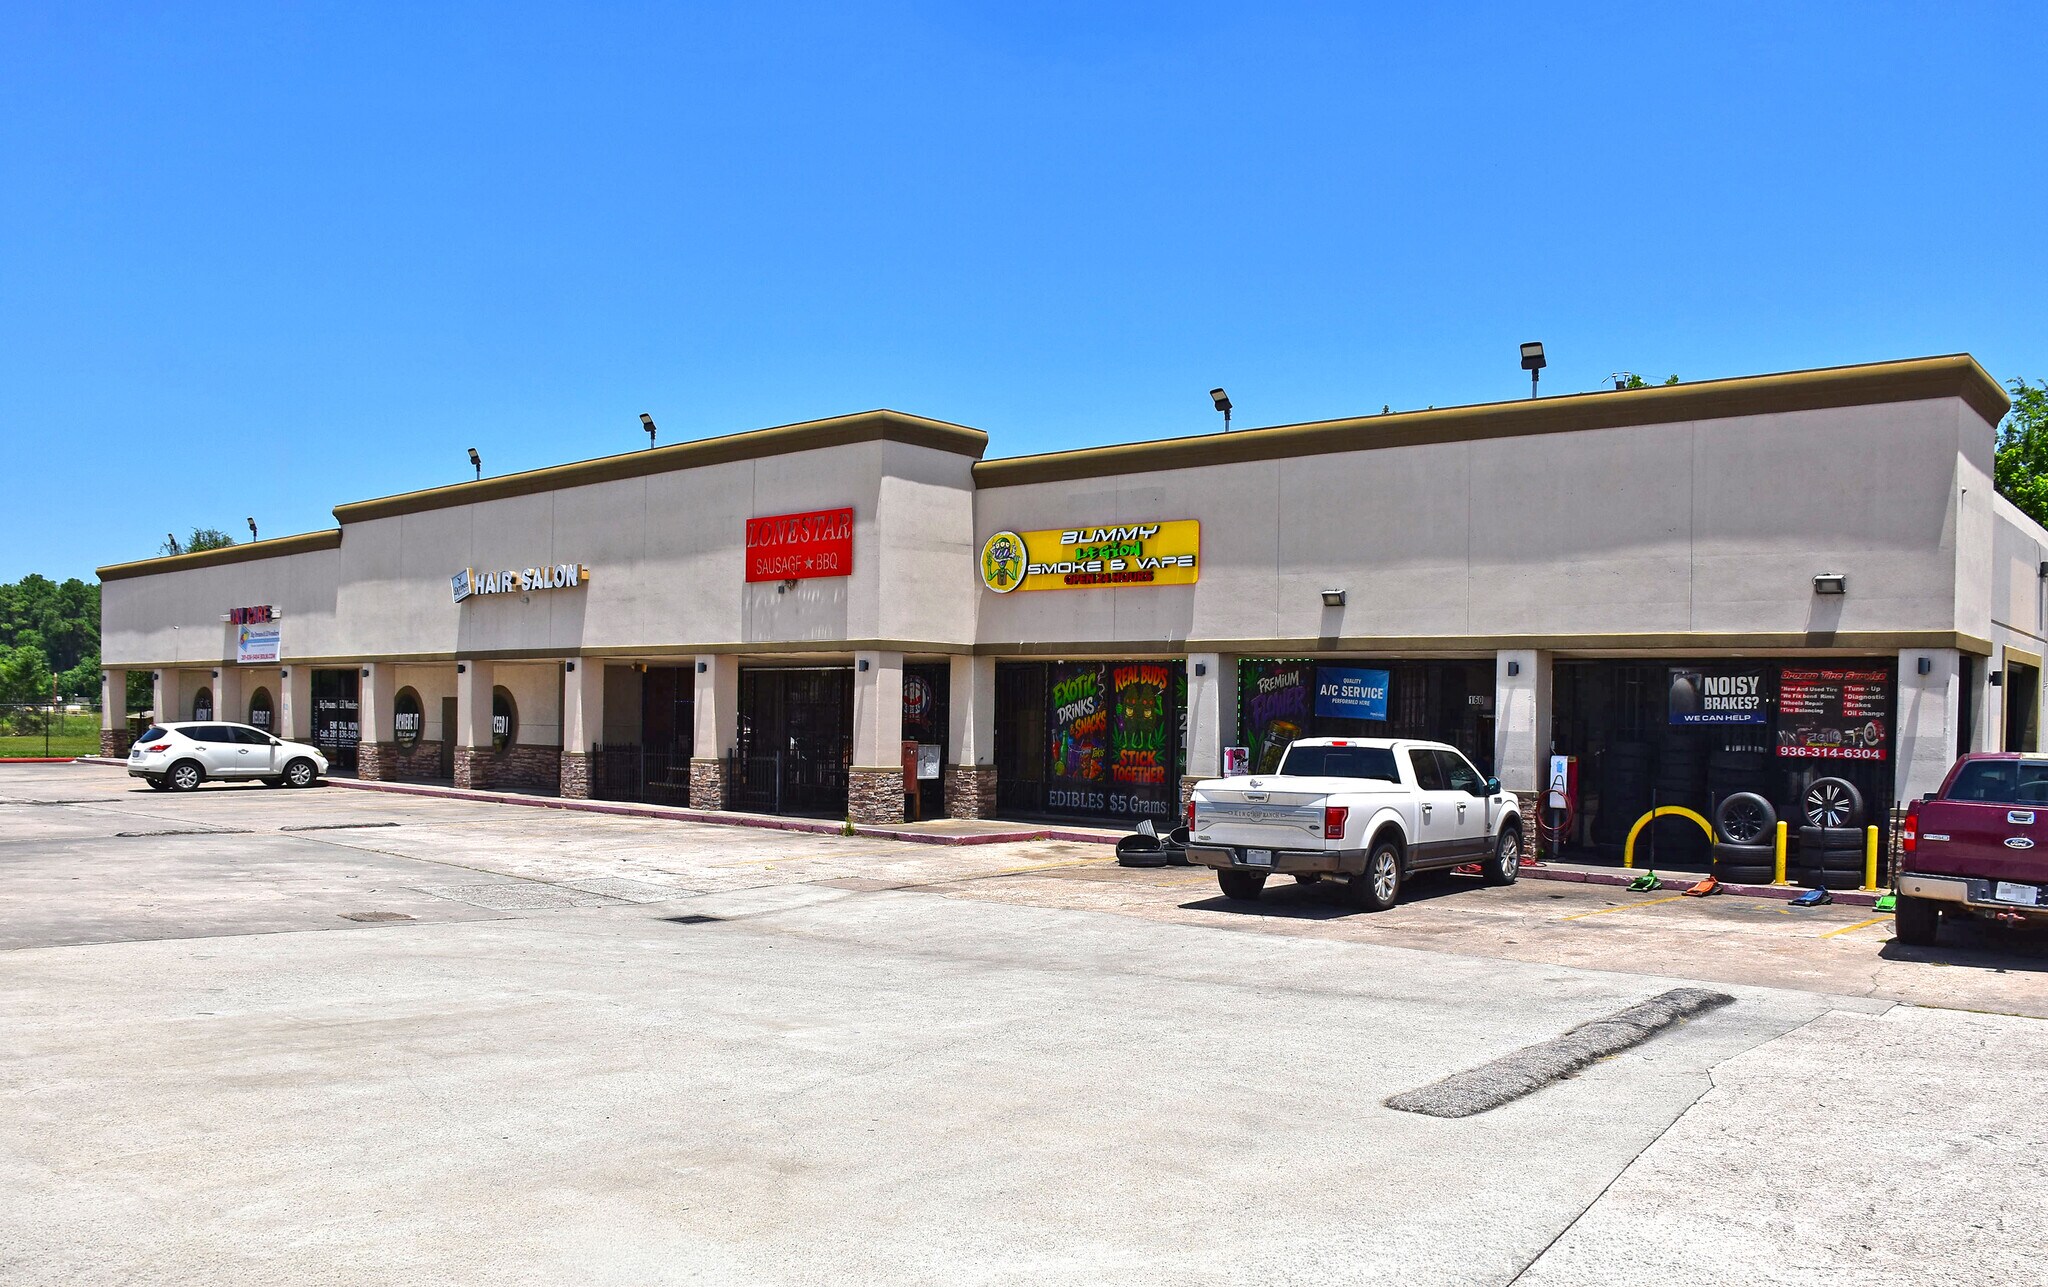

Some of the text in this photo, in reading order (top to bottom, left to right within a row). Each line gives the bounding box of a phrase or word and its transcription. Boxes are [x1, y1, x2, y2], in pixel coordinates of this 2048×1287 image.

[747, 513, 851, 548] LONESTAR
[1060, 525, 1159, 545] BUMMY
[1075, 540, 1144, 561] LEGION
[756, 552, 838, 575] SAUSAGE BBQ
[1027, 555, 1195, 575] SMOKE & VAPE
[475, 570, 516, 595] HAIR
[521, 563, 581, 592] SALON
[1063, 570, 1154, 585] OPEN 24 HOURS
[230, 605, 272, 625] DAY CARE
[1113, 665, 1168, 692] REAL BUDS
[1257, 670, 1299, 694] PREMIUM
[1704, 676, 1759, 695] NOISY
[1821, 671, 1843, 680] Tire
[1844, 671, 1886, 681] Service
[1053, 672, 1097, 708] EXOTIC
[1320, 684, 1383, 699] A/C SERVICE
[1057, 696, 1095, 725] DRINKS
[1704, 692, 1760, 710] BRAKES?
[1795, 707, 1824, 715] Balancing
[395, 713, 419, 730] ACHIEVE IT
[1074, 710, 1107, 740] SNACKS
[1858, 711, 1885, 719] change
[1119, 750, 1157, 766] STICK
[1780, 746, 1880, 759] 936-314-6304
[1112, 764, 1165, 784] TOGETHER
[1049, 790, 1104, 810] EDIBLES
[1109, 792, 1127, 812] $5
[1129, 795, 1167, 814] Grams
[1234, 810, 1250, 818] KING
